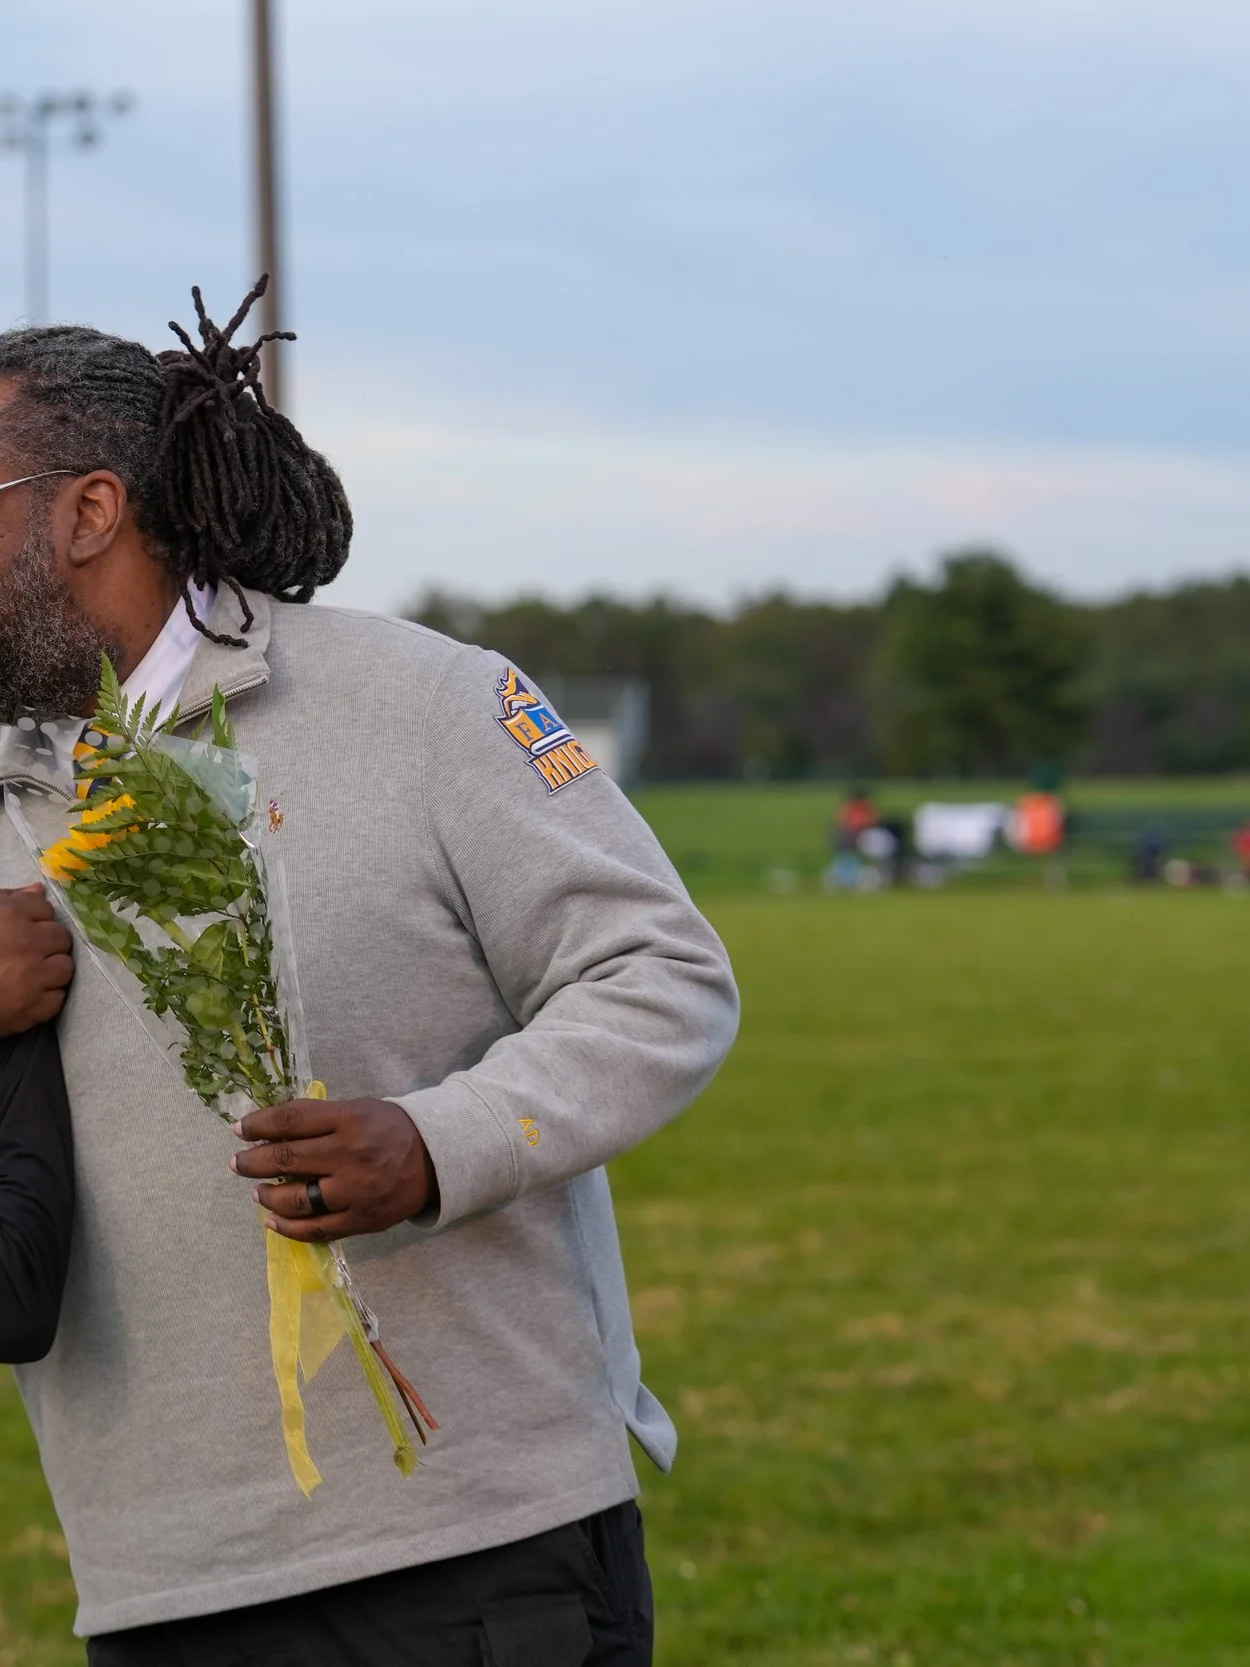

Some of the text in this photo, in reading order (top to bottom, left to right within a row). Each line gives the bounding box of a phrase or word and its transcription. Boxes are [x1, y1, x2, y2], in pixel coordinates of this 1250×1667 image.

[516, 713, 558, 741] F A
[519, 1118, 540, 1146] AD
